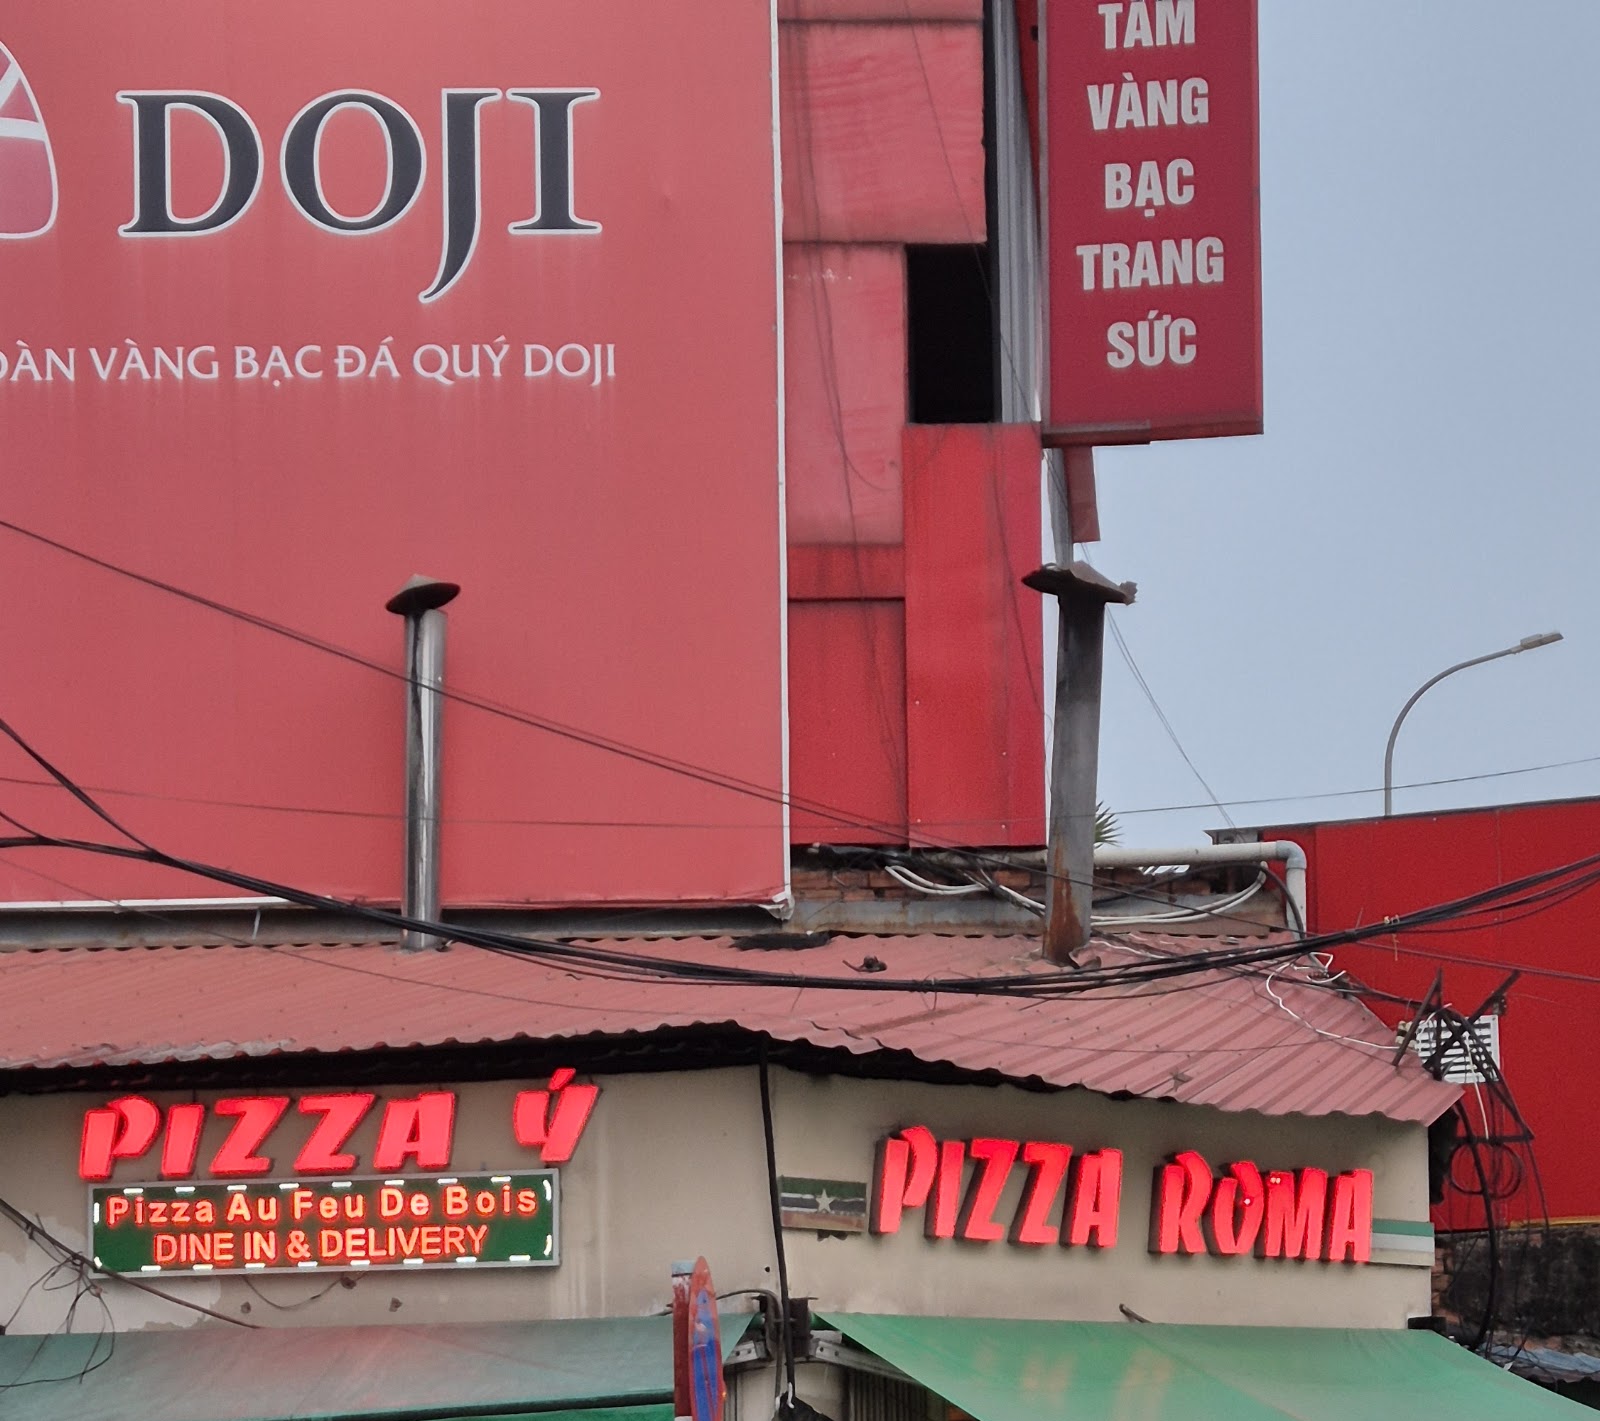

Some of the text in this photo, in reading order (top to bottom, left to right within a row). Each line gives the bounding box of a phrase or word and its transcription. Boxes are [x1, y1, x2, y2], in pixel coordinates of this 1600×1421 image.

[1086, 72, 1210, 131] VÀNG
[115, 87, 601, 304] DOJI
[1104, 158, 1195, 218] BẠC
[1076, 236, 1225, 291] TRANG
[0, 335, 616, 387] ÀN VÀNG BẠC ĐÁ QUÝ DOJI
[1106, 310, 1197, 369] SỨC
[80, 1093, 456, 1178] PIZZA
[107, 1182, 538, 1227] Pizza Au Feu De Bois
[872, 1126, 1374, 1262] PIZZA ROMA
[154, 1223, 488, 1263] DINE IN & DELIVERY
